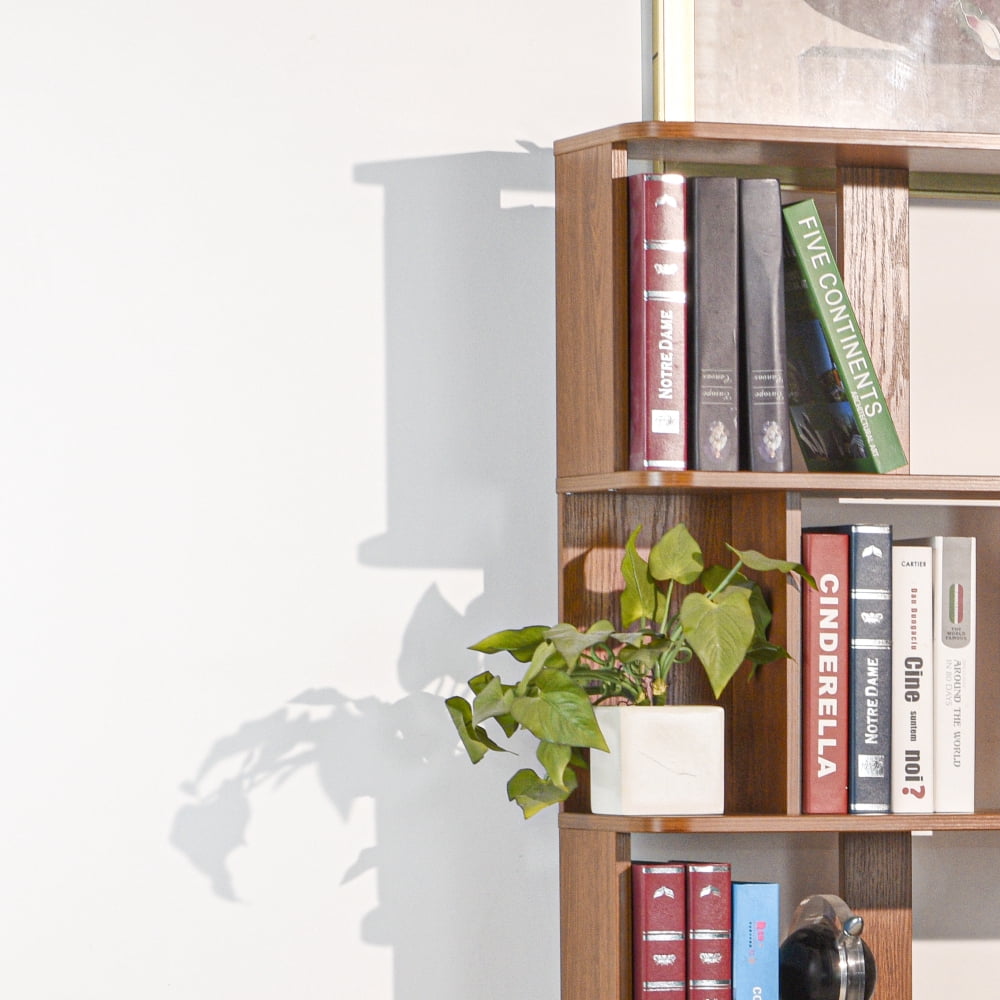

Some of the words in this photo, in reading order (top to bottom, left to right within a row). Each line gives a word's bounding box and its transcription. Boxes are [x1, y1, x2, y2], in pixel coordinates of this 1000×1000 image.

[658, 310, 673, 352] DAME
[798, 216, 831, 269] FIVE
[819, 273, 883, 417] CONTINENTS
[658, 353, 673, 400] NOTRE
[817, 573, 839, 778] CINDERELLA
[864, 657, 879, 697] DAME
[904, 656, 923, 702] Cine
[953, 659, 962, 703] AROUND
[864, 698, 878, 744] NOTRE
[909, 711, 917, 741] suntem
[953, 708, 961, 727] THE
[953, 731, 961, 768] WORLD
[902, 750, 926, 799] noi?
